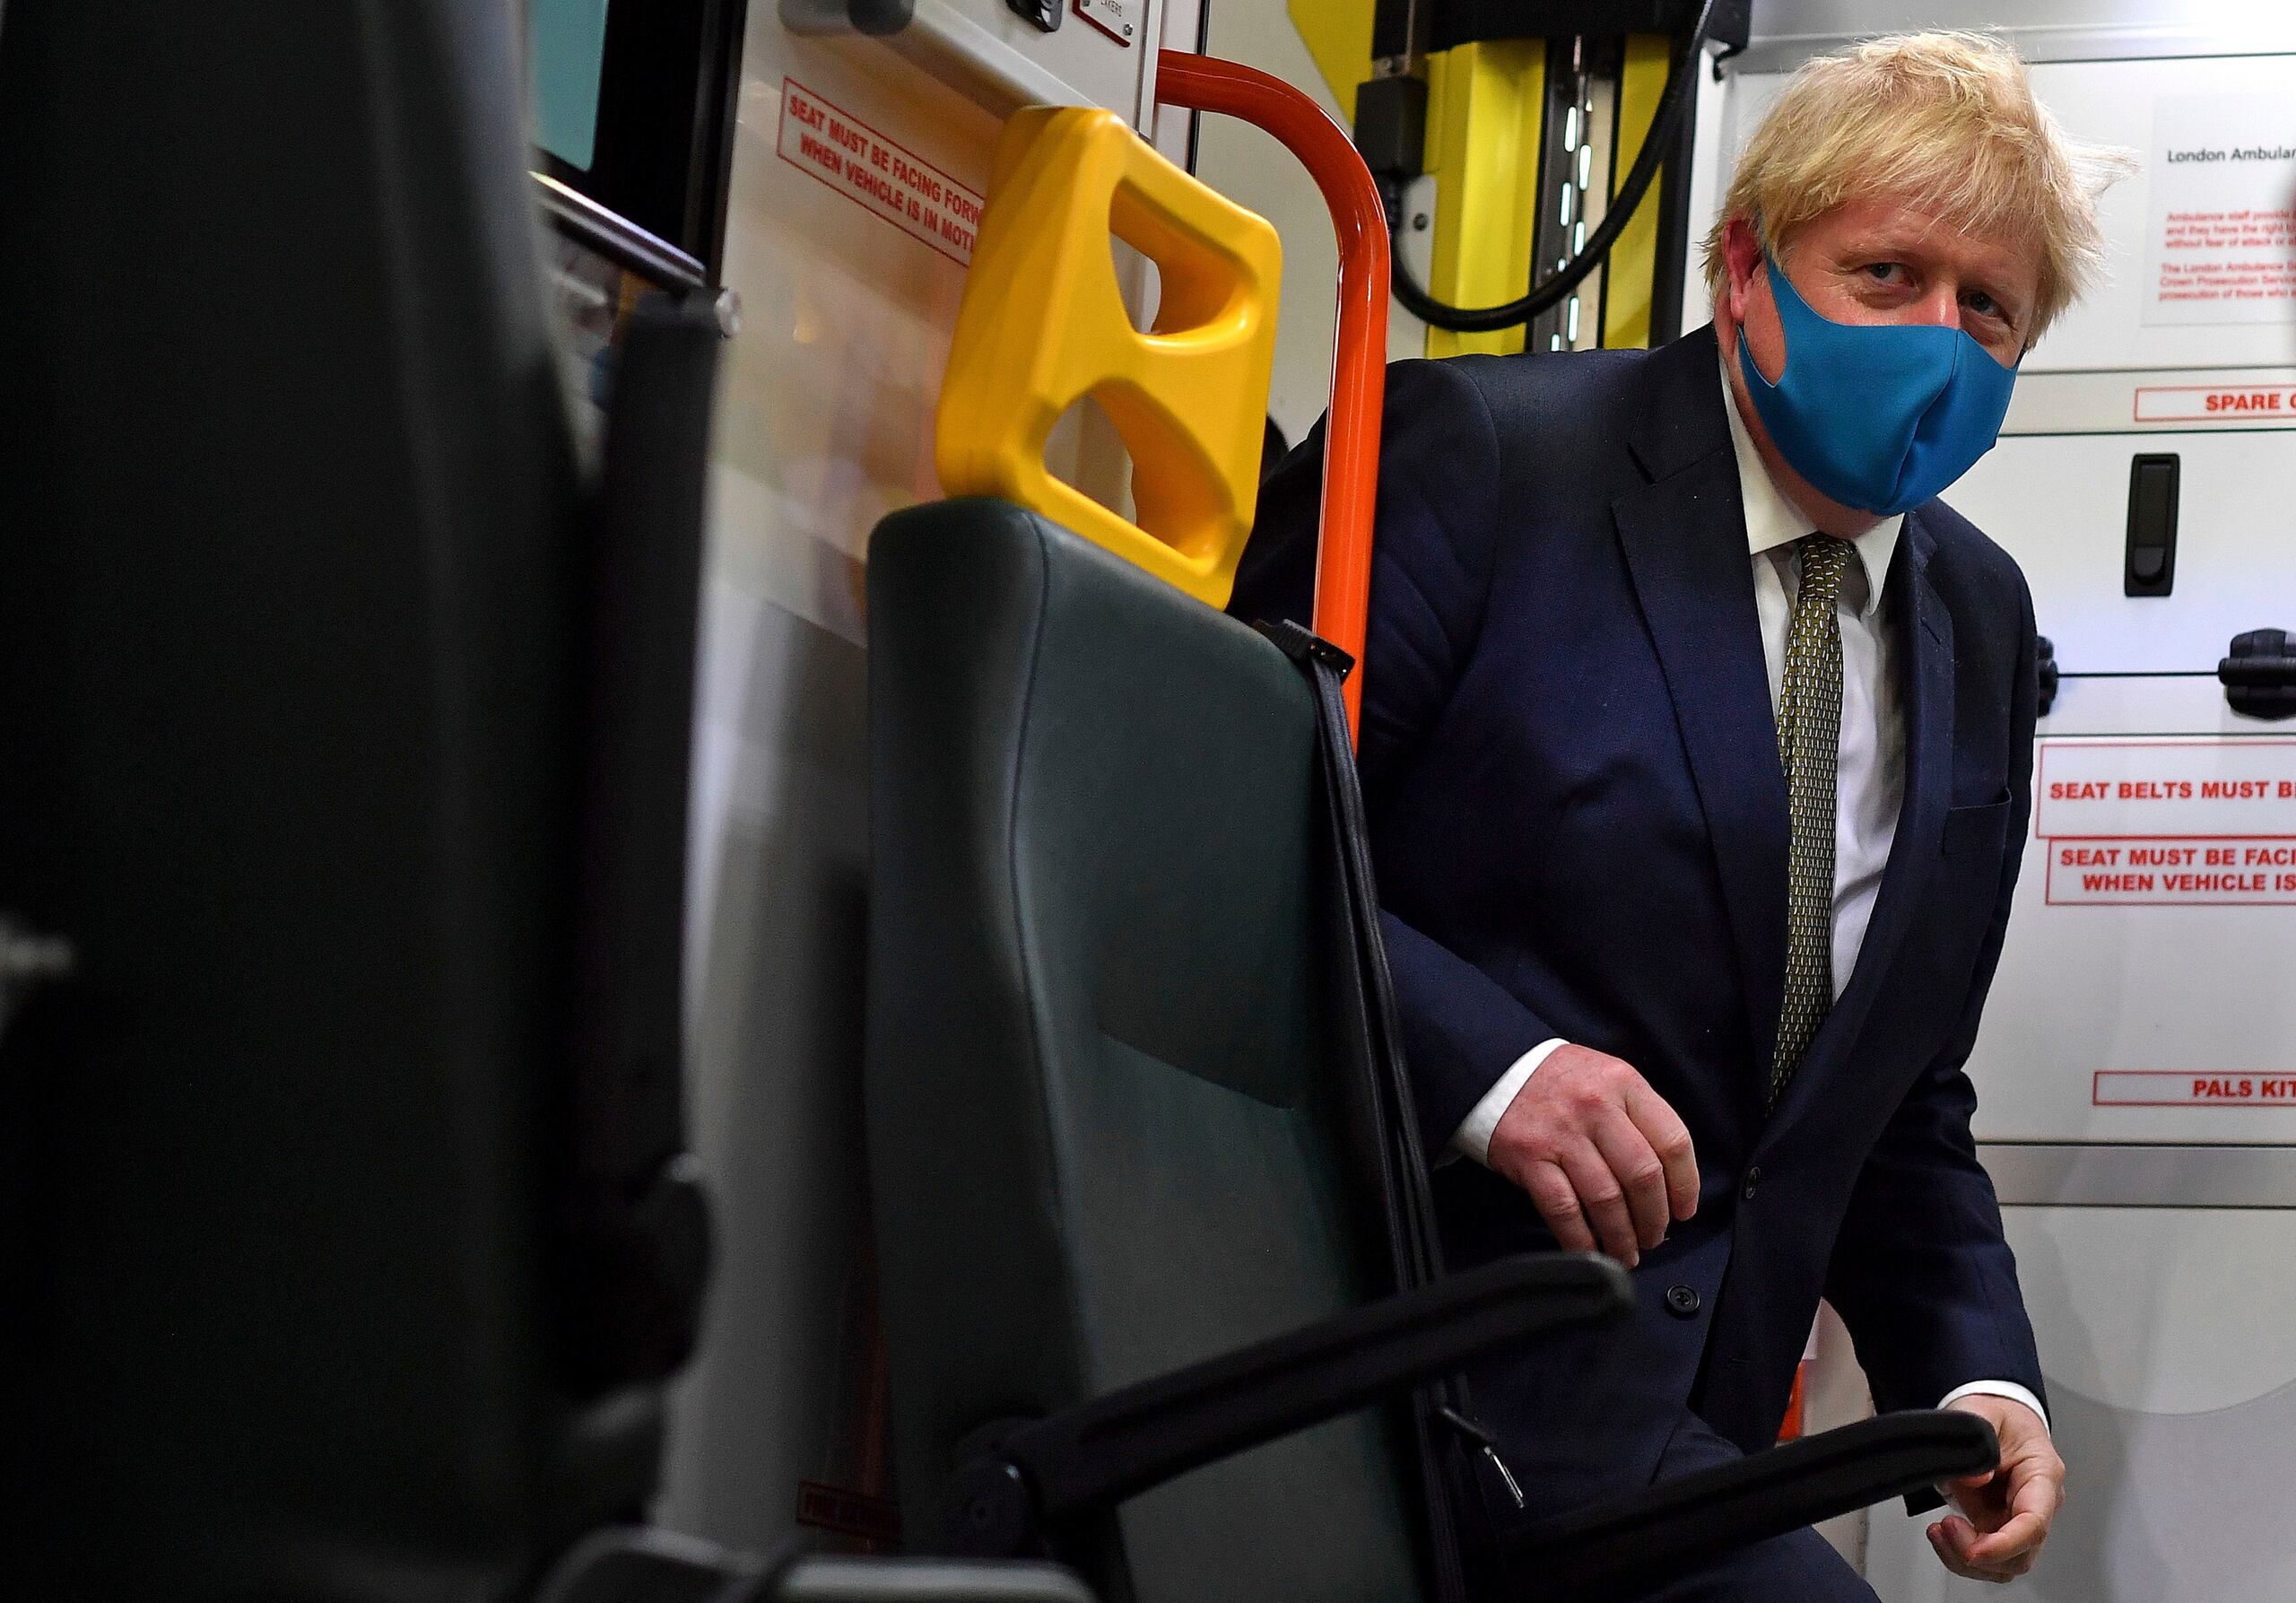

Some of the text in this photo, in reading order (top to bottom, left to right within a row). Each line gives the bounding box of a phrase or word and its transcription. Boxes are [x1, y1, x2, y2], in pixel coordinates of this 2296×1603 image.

[790, 95, 826, 132] SEAT
[829, 118, 868, 158] MUST
[872, 144, 889, 172] BE
[893, 156, 941, 203] FACING
[2168, 148, 2225, 162] London
[801, 133, 842, 175] WHEN
[847, 160, 903, 213] VEHICLE
[908, 197, 919, 222] IS
[925, 207, 937, 232] IN
[2206, 394, 2281, 410] SPARE
[2050, 781, 2296, 799] SEAT BELTS MUST B
[2061, 849, 2296, 866] SEAT MUST BE FACI
[2083, 874, 2296, 891] WHEN VEHICLE IS
[2194, 1079, 2253, 1097] PALS
